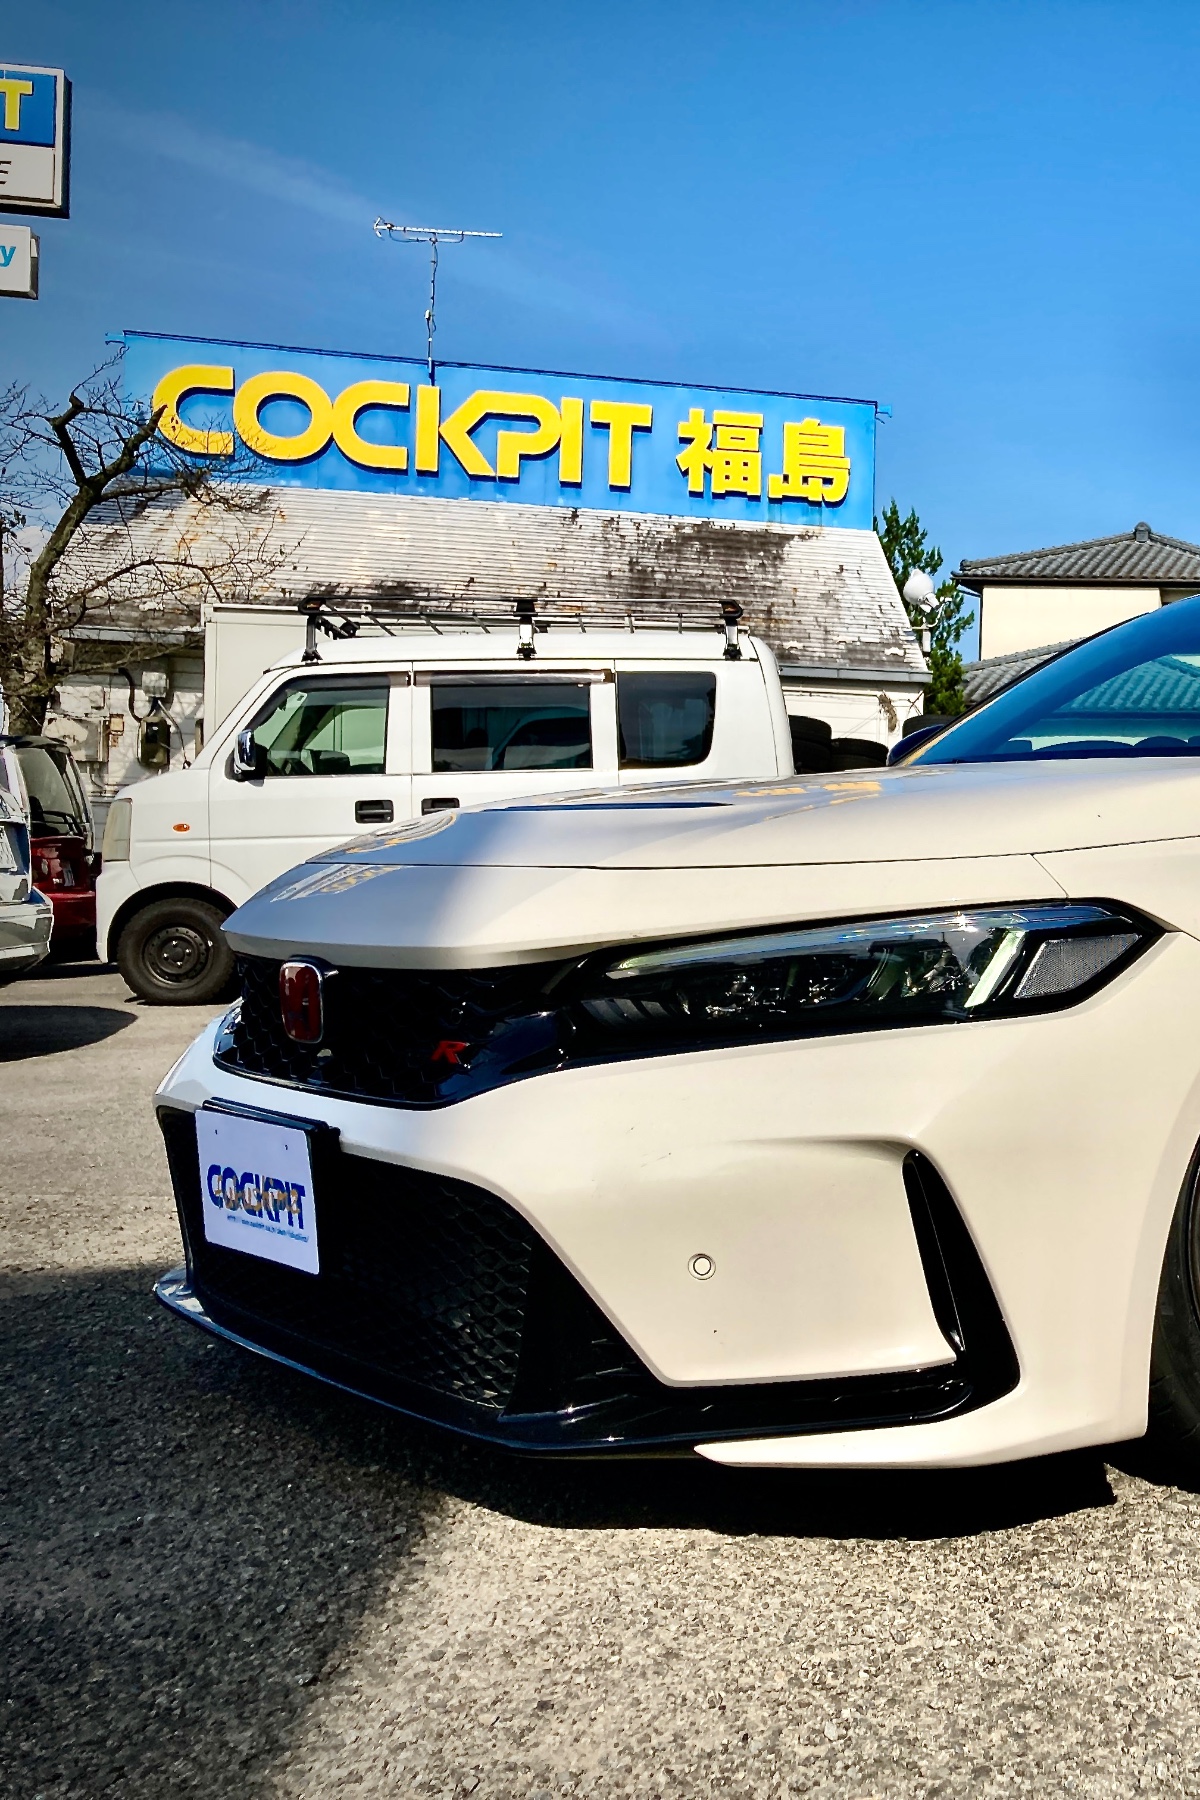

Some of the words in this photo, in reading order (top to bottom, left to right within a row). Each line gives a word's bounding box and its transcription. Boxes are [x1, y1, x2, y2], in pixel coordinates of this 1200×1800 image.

[152, 364, 653, 488] COCKPIT
[676, 408, 851, 504] 福島
[431, 1040, 468, 1064] R
[207, 1164, 306, 1230] COCKPIT
